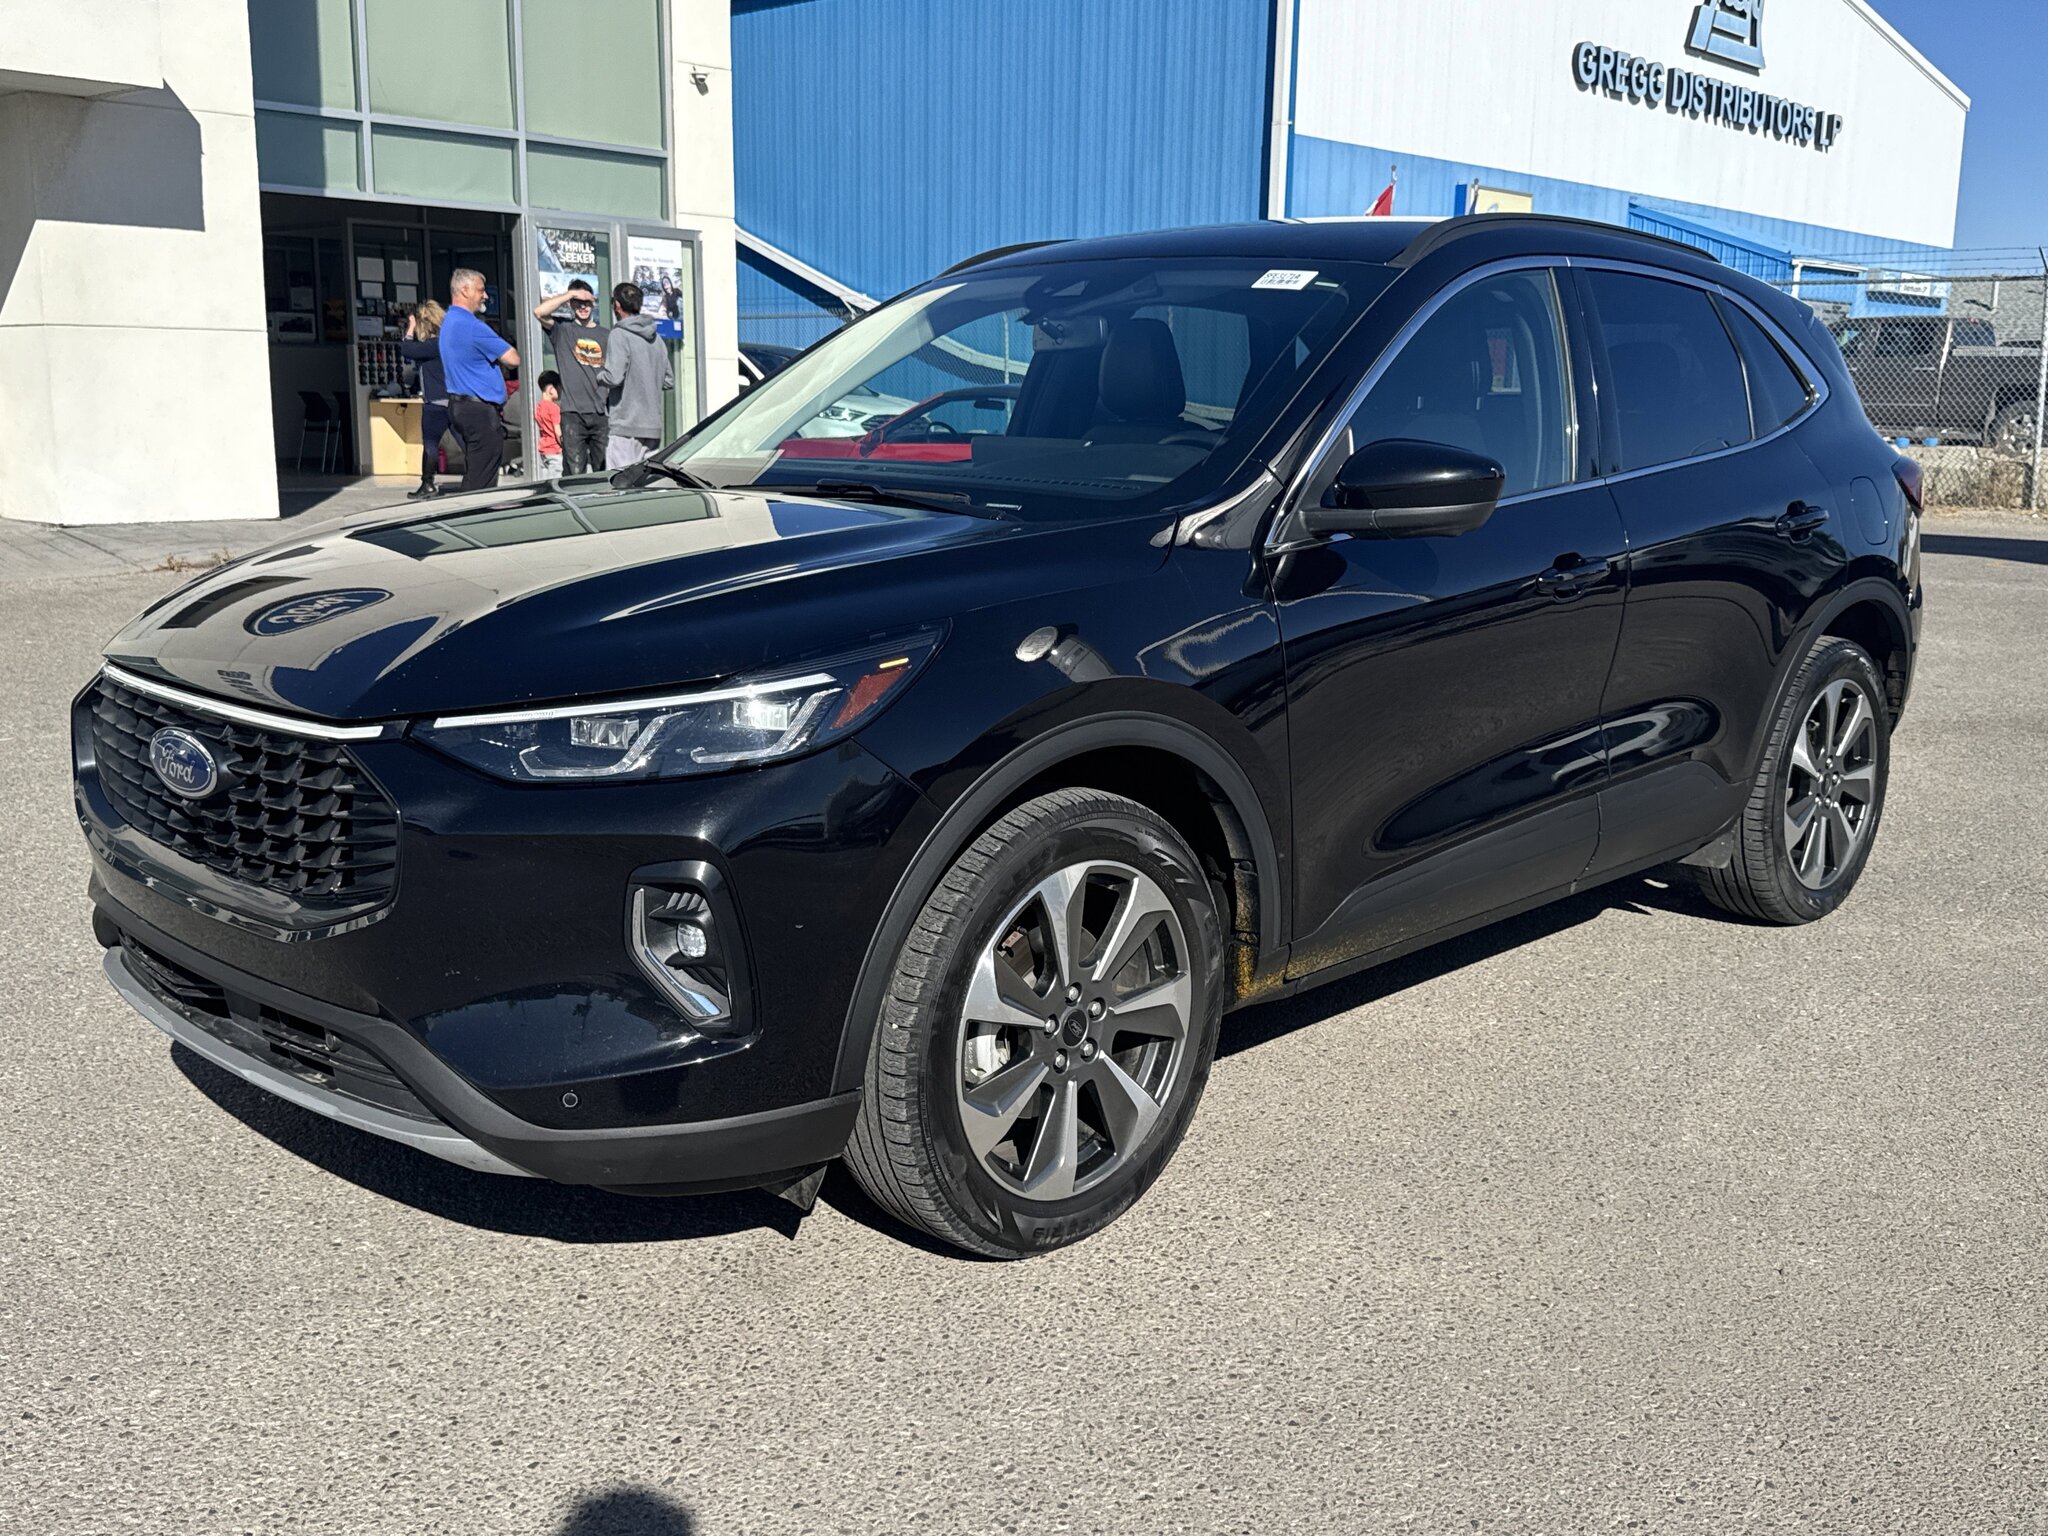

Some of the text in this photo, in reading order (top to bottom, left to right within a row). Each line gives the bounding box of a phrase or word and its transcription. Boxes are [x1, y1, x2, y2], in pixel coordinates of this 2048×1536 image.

[1573, 40, 1665, 102] GREGG
[1669, 67, 1816, 142] DISTRIBUTORS
[560, 253, 596, 264] SEEKER
[157, 742, 195, 784] Ford
